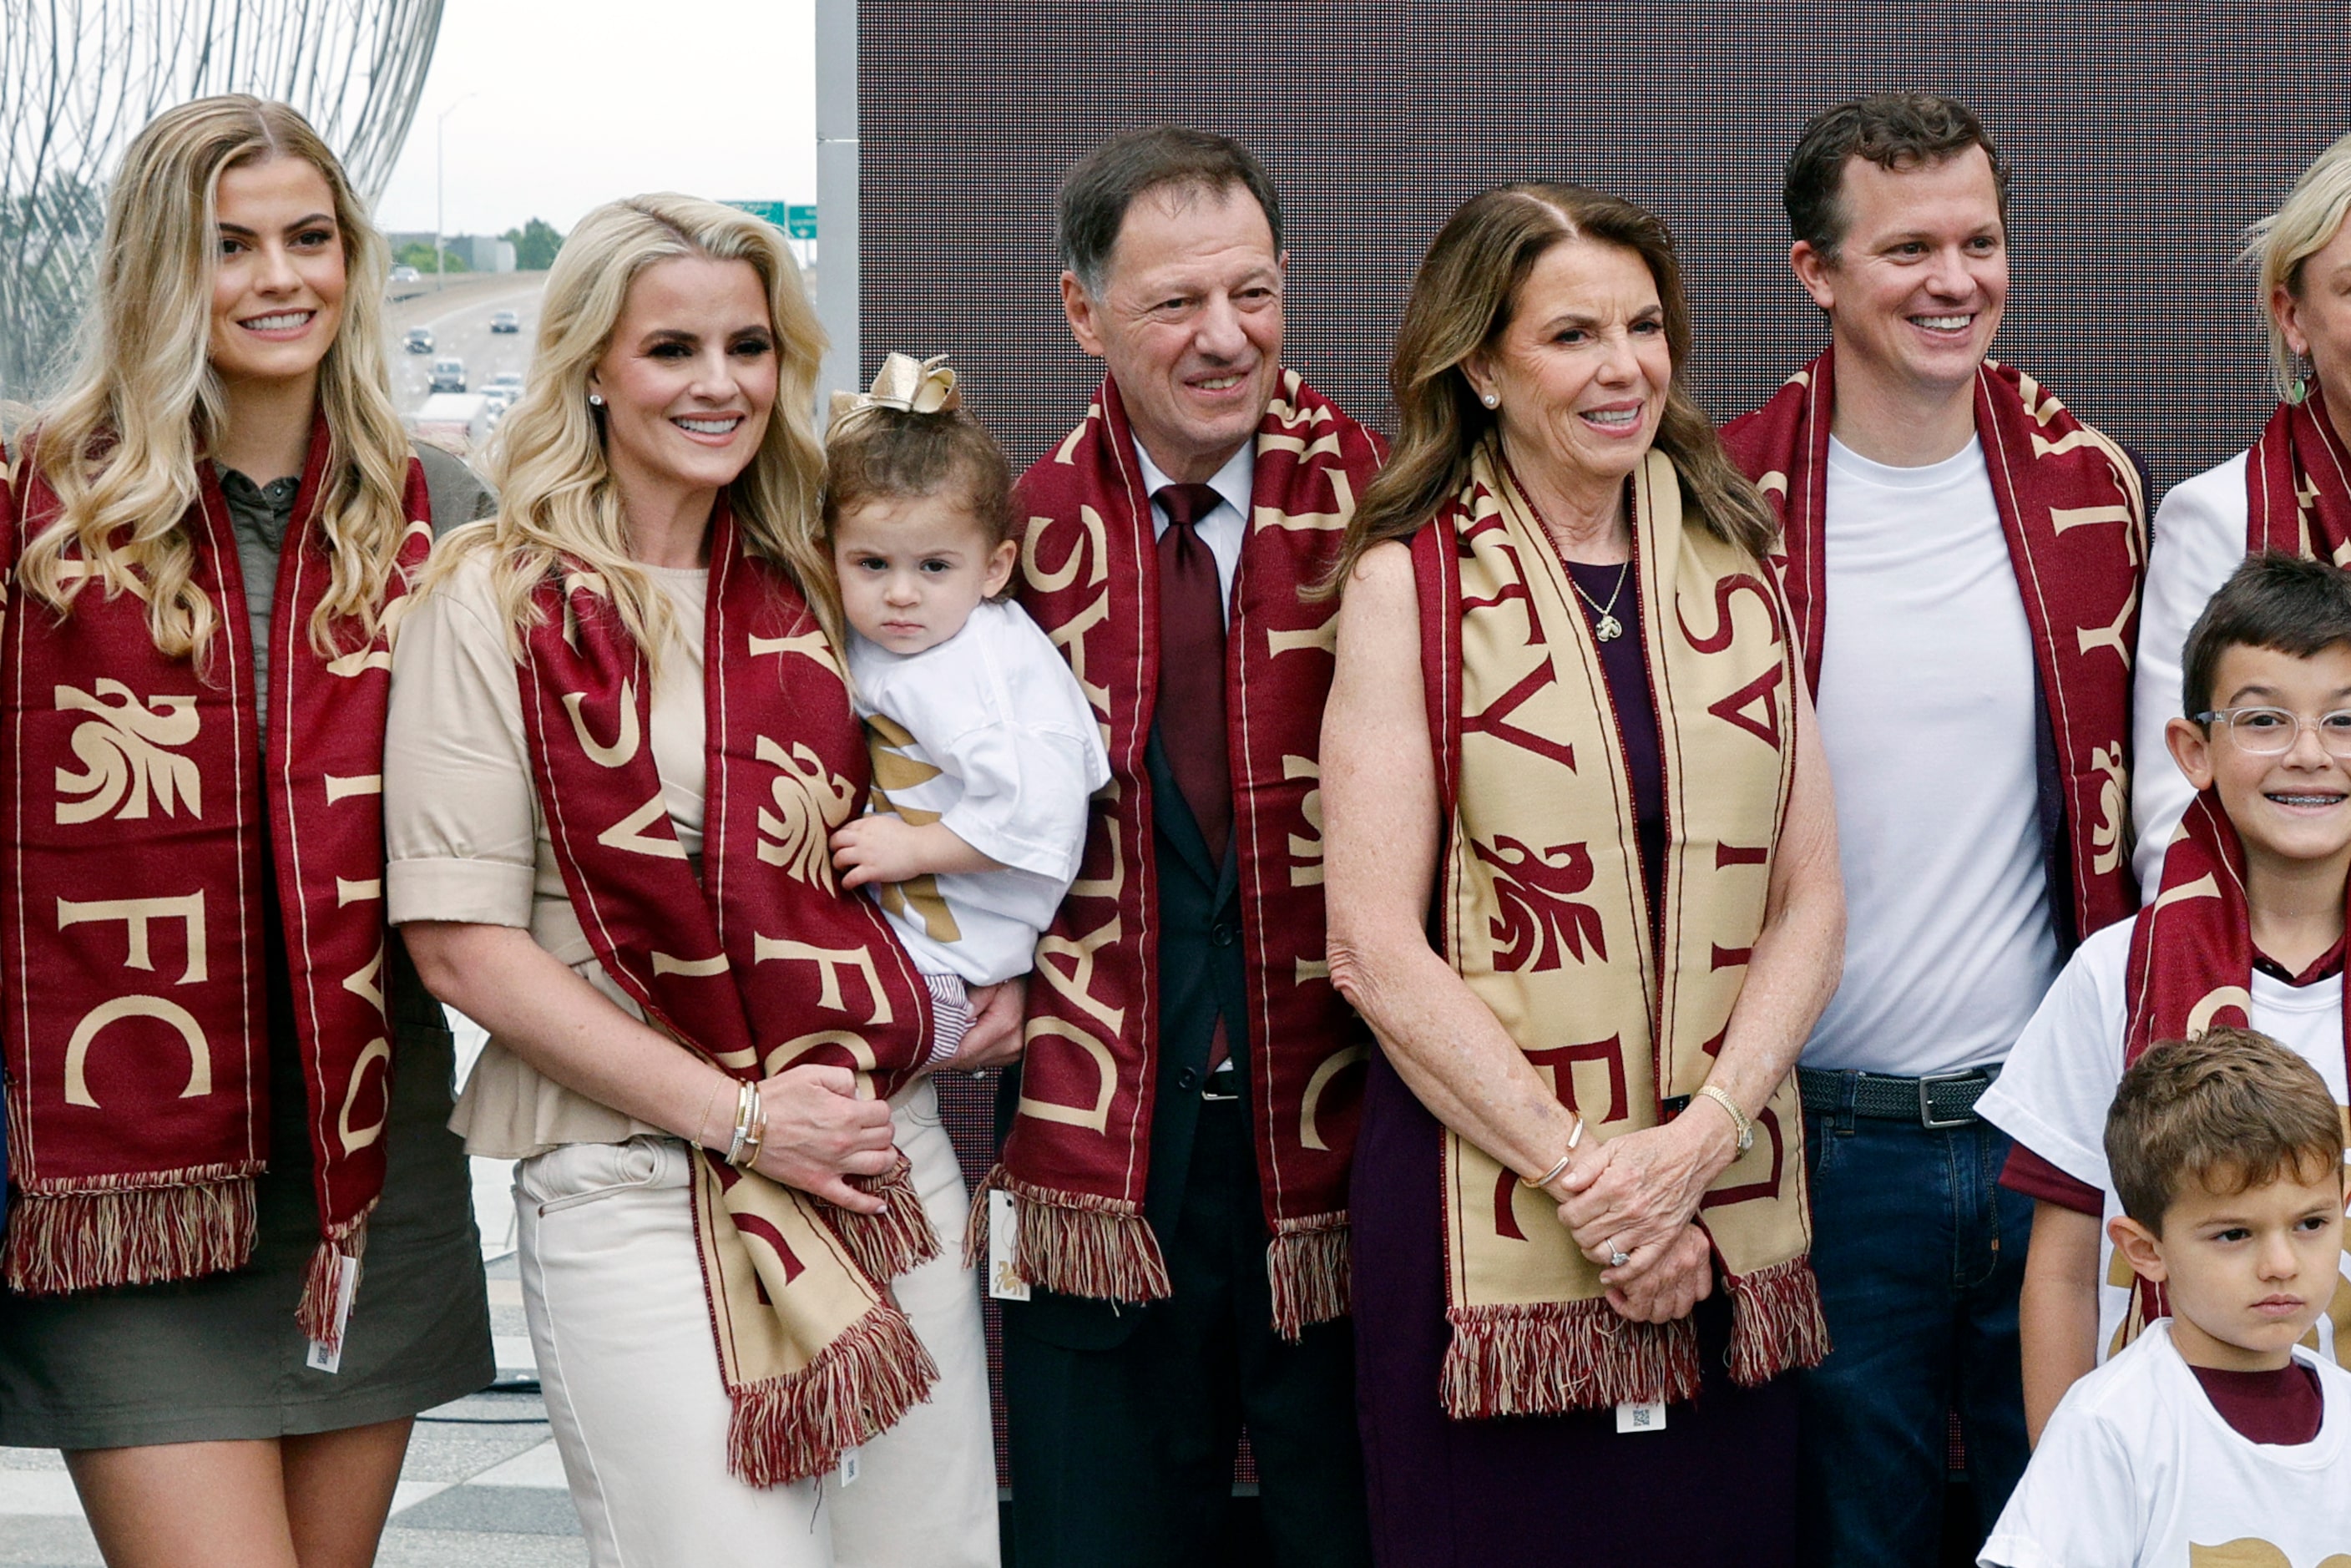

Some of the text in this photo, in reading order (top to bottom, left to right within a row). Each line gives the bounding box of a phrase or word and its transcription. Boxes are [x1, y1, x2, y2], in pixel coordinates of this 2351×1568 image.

[1019, 503, 1125, 1136] DALAS
[56, 888, 212, 1110] FC
[754, 930, 893, 1101] FC
